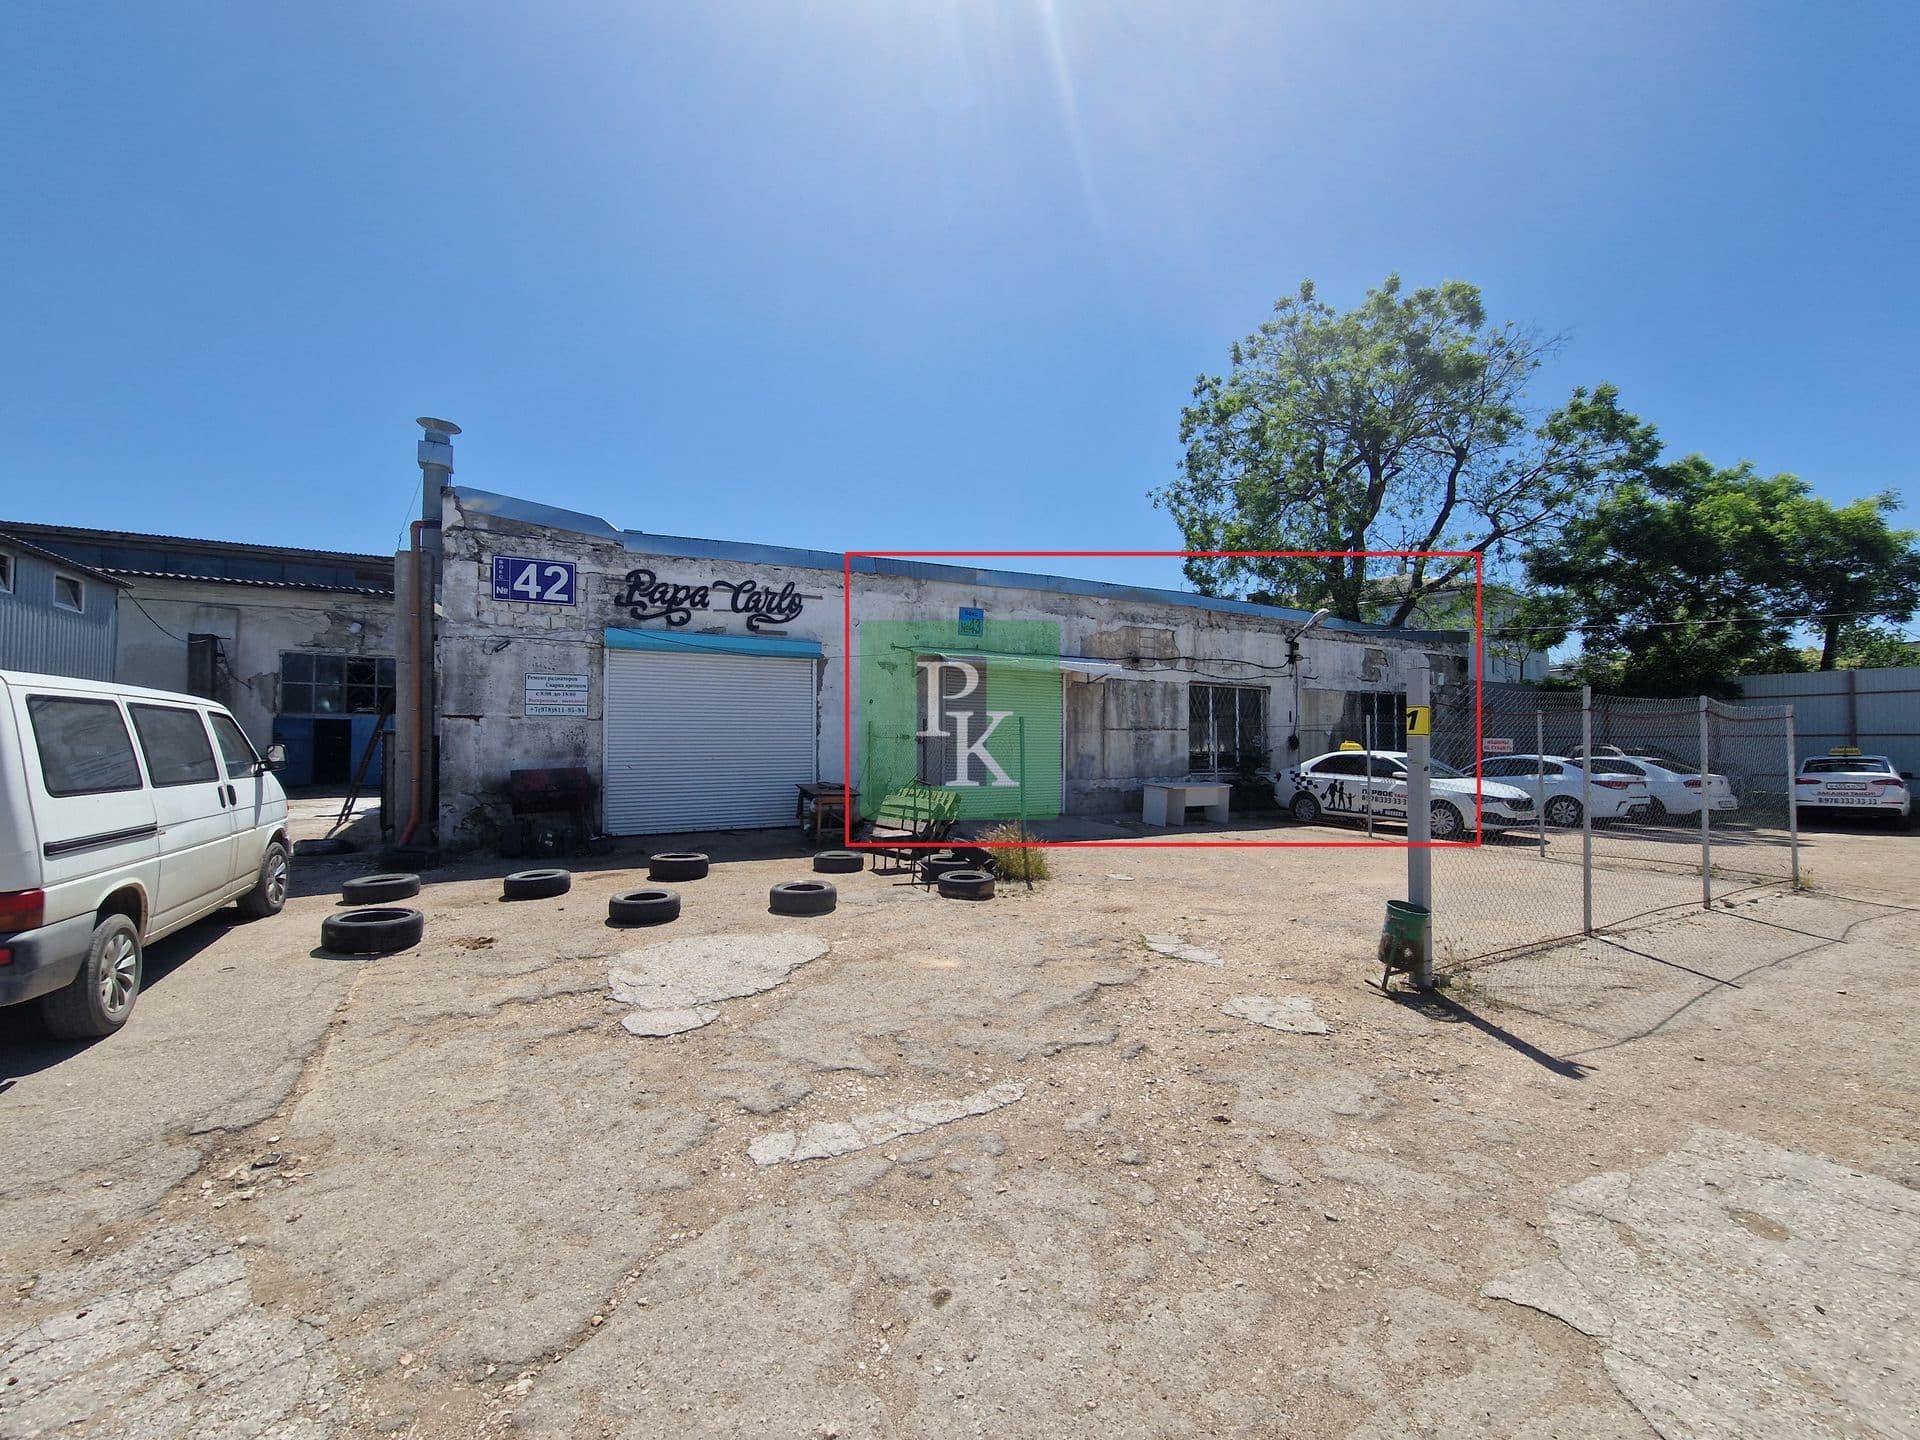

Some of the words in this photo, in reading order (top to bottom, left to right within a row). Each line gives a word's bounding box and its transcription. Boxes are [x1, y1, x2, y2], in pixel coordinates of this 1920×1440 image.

[513, 563, 569, 601] 42
[614, 569, 710, 626] Papa
[712, 580, 803, 631] Carlo
[1361, 788, 1394, 797] ПРВОЕ
